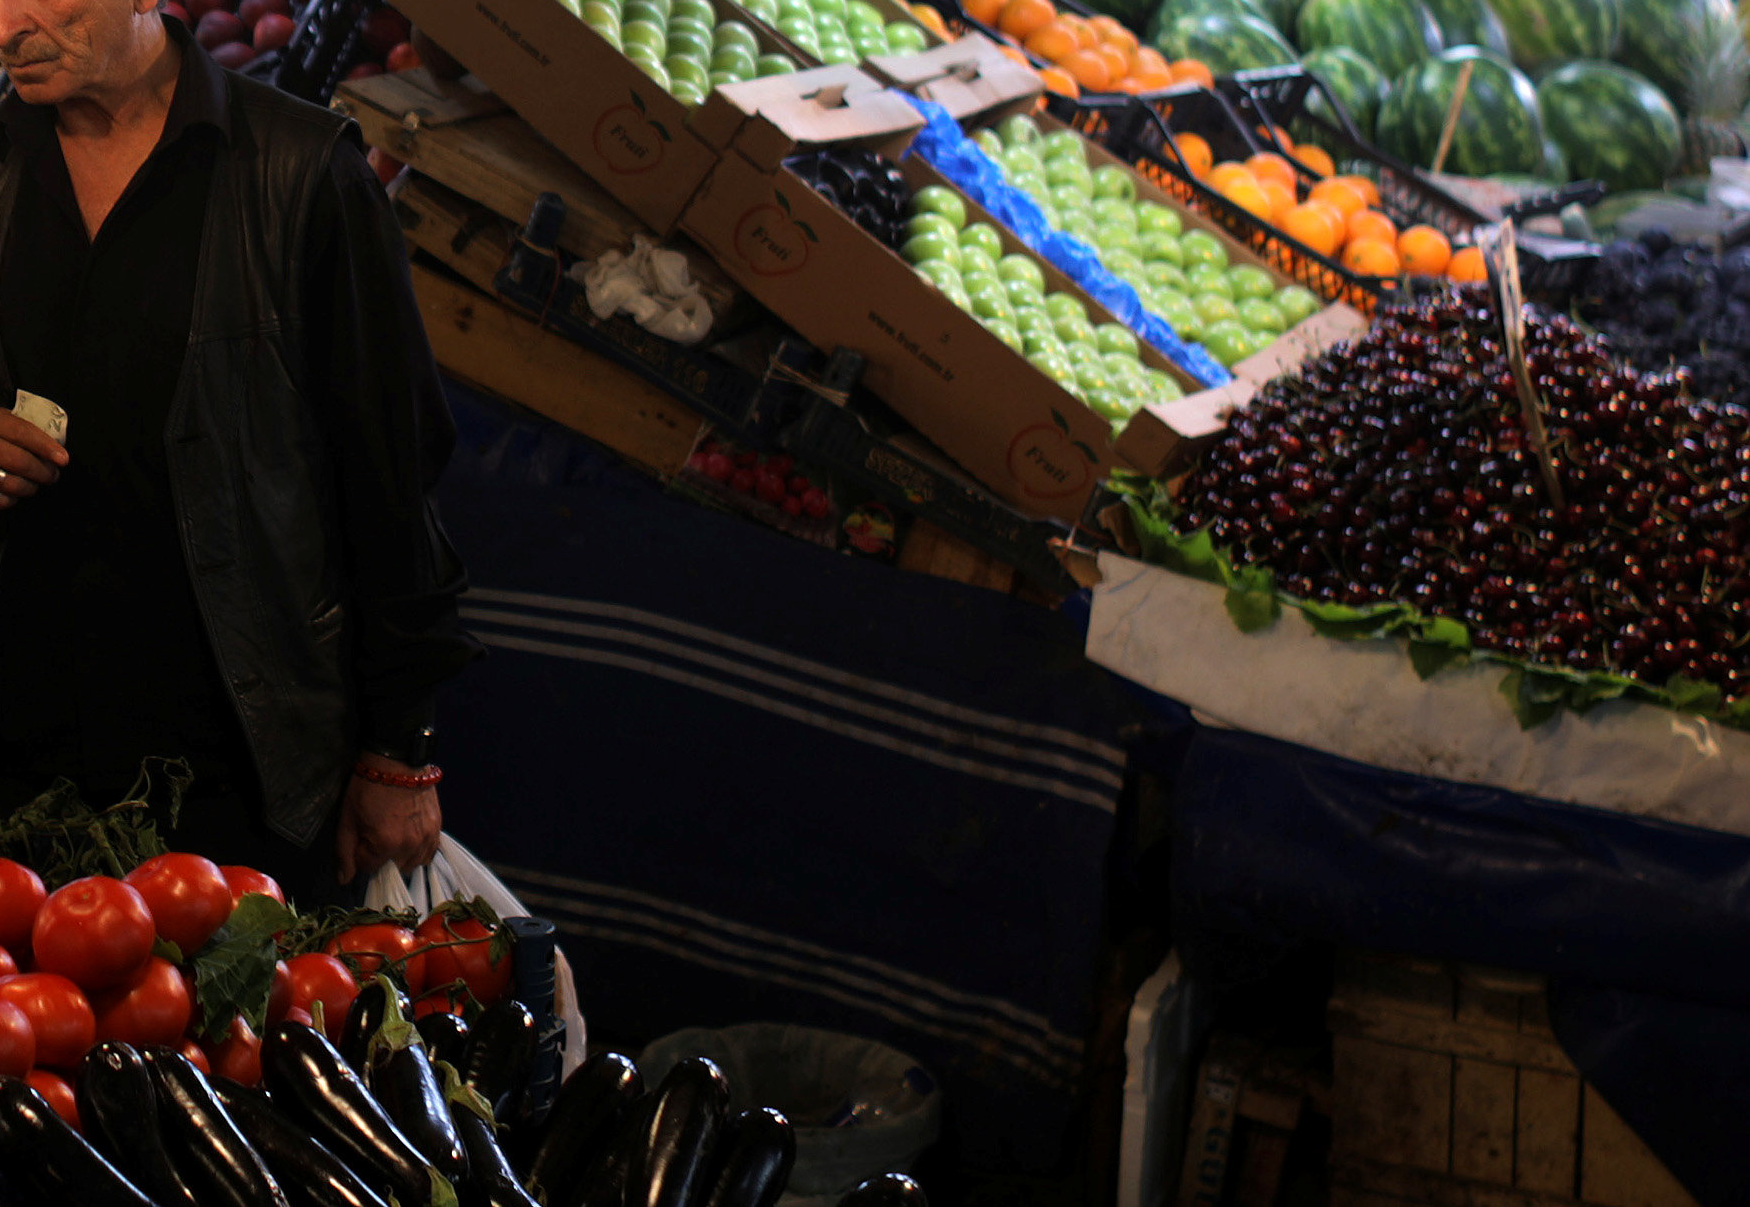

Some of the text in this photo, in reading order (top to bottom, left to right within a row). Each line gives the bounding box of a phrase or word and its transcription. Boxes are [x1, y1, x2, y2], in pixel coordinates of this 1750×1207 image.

[610, 124, 649, 159] Fruti
[751, 226, 790, 262] Fruti
[868, 310, 955, 382] www.fruti.com.tr
[1025, 445, 1071, 483] Fruti
